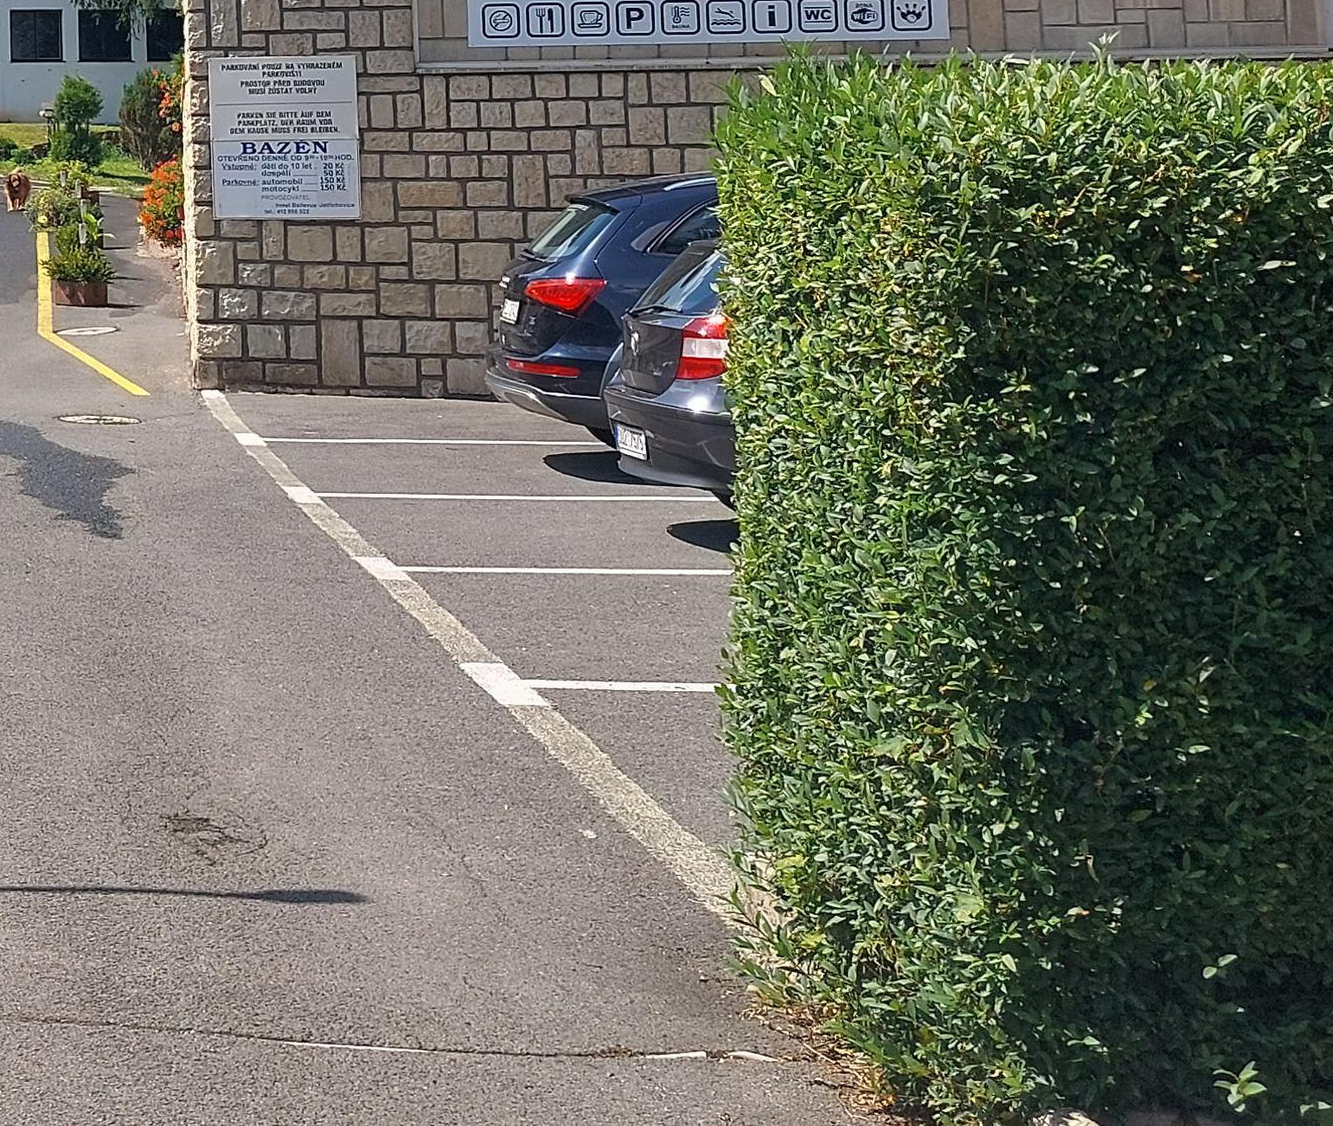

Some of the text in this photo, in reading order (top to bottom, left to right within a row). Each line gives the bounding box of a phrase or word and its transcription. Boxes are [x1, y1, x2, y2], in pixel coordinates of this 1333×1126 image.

[626, 7, 645, 29] P
[804, 9, 832, 21] WC
[221, 63, 260, 71] PARKOVÁNÍ
[241, 140, 329, 154] BAZÉN
[217, 154, 259, 162] OTEVŘENO
[221, 163, 257, 171] Vstupné:
[261, 169, 291, 177] dospělí
[261, 185, 300, 193] motocykl
